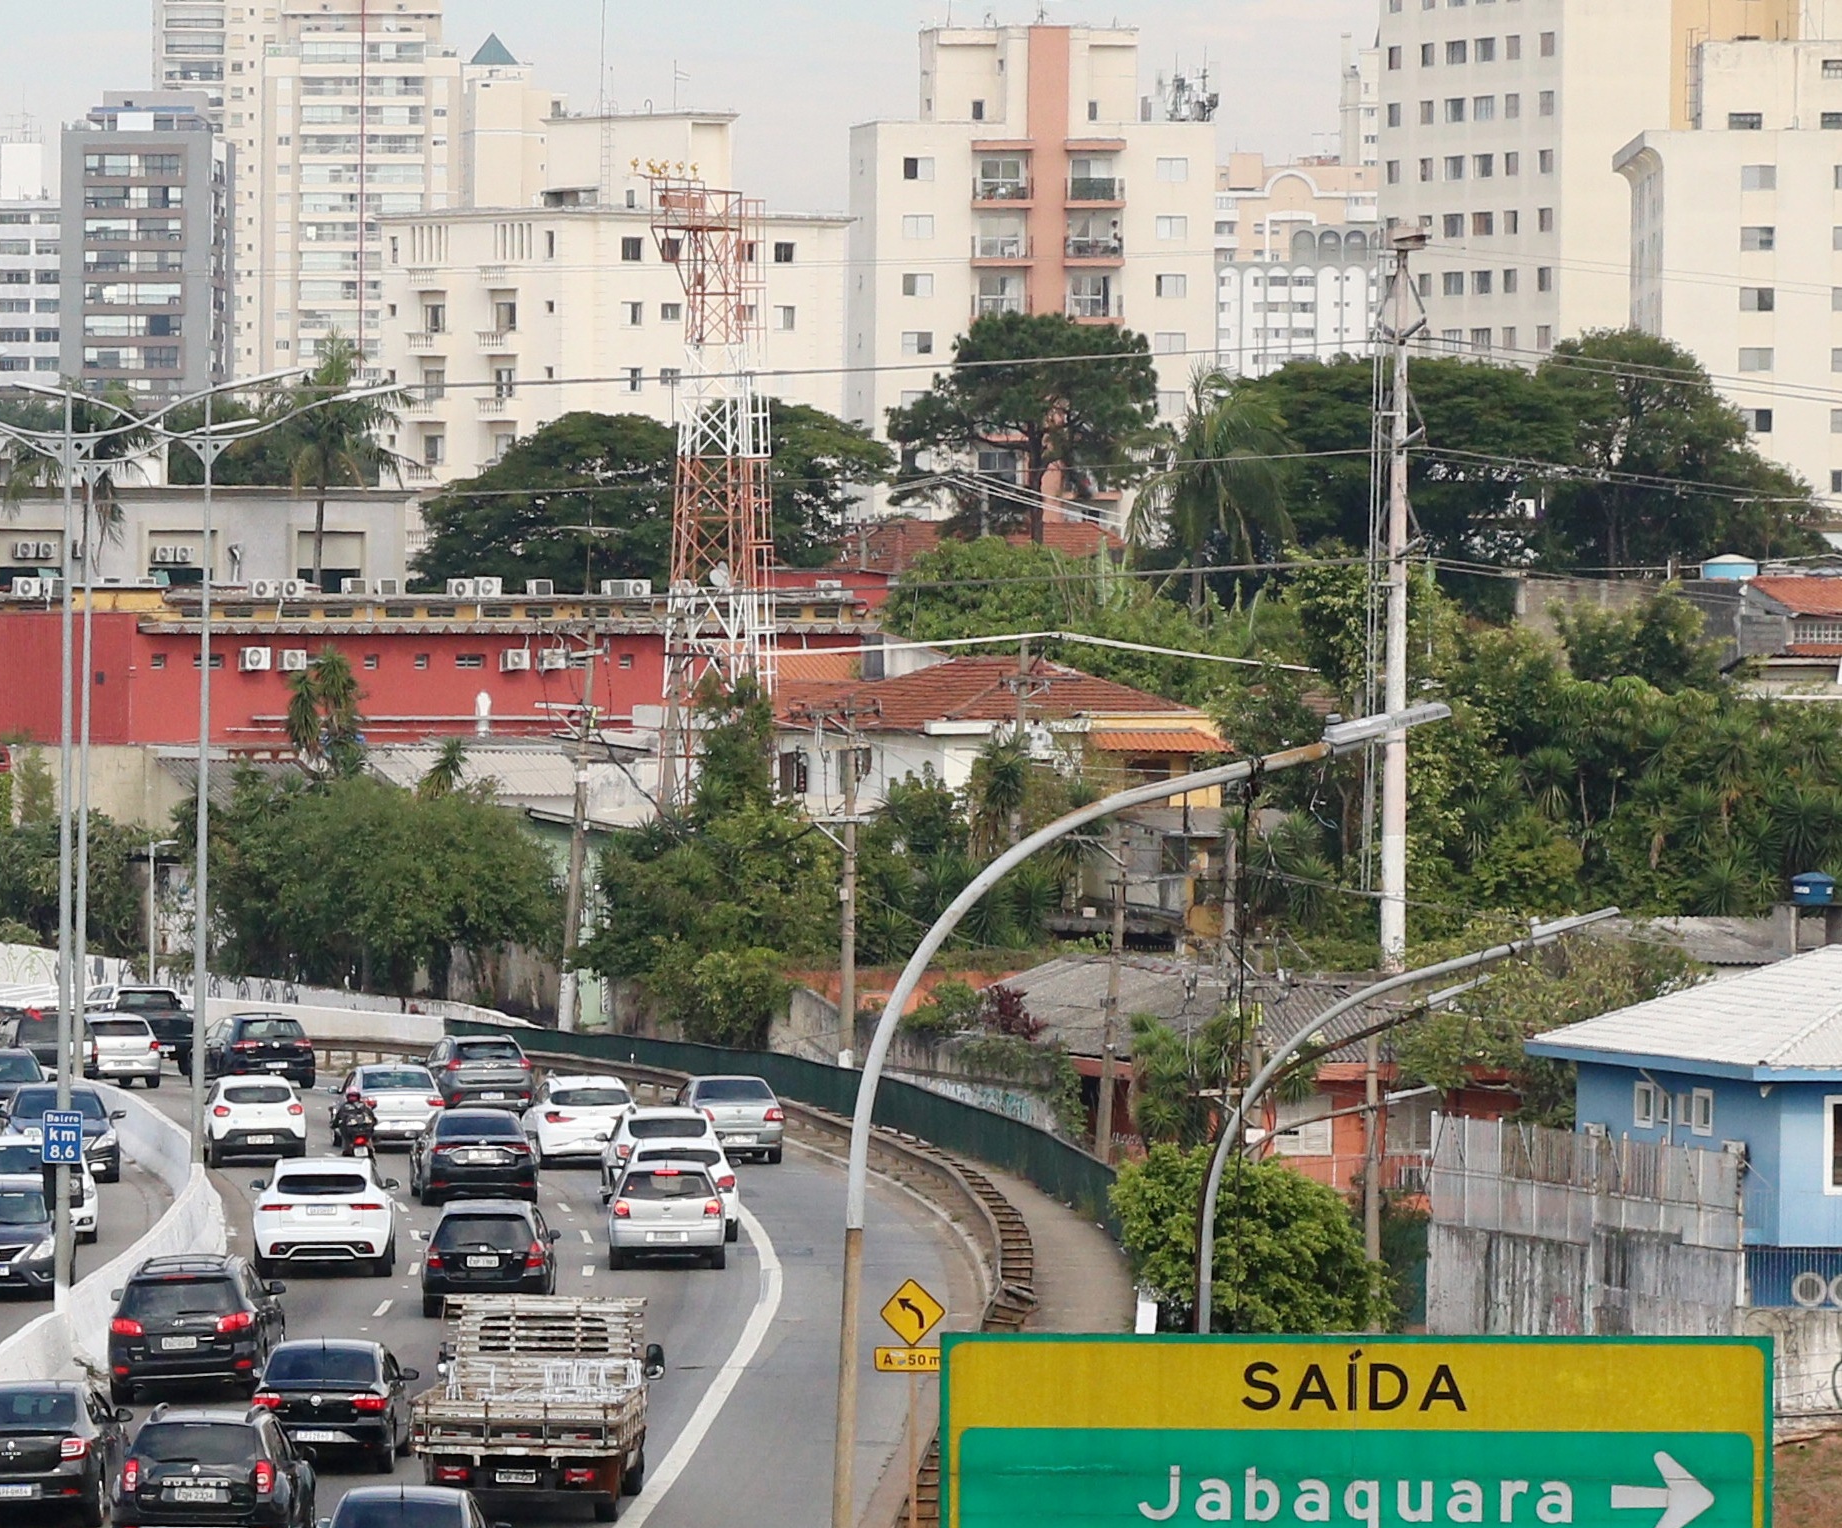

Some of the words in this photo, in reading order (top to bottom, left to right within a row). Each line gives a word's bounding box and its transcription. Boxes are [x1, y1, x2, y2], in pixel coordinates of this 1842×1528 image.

[47, 1113, 79, 1124] Bairro
[49, 1127, 76, 1142] km
[50, 1146, 75, 1160] 8,6
[884, 1353, 893, 1364] A
[908, 1352, 926, 1365] 50
[1241, 1349, 1467, 1412] SAÍDA
